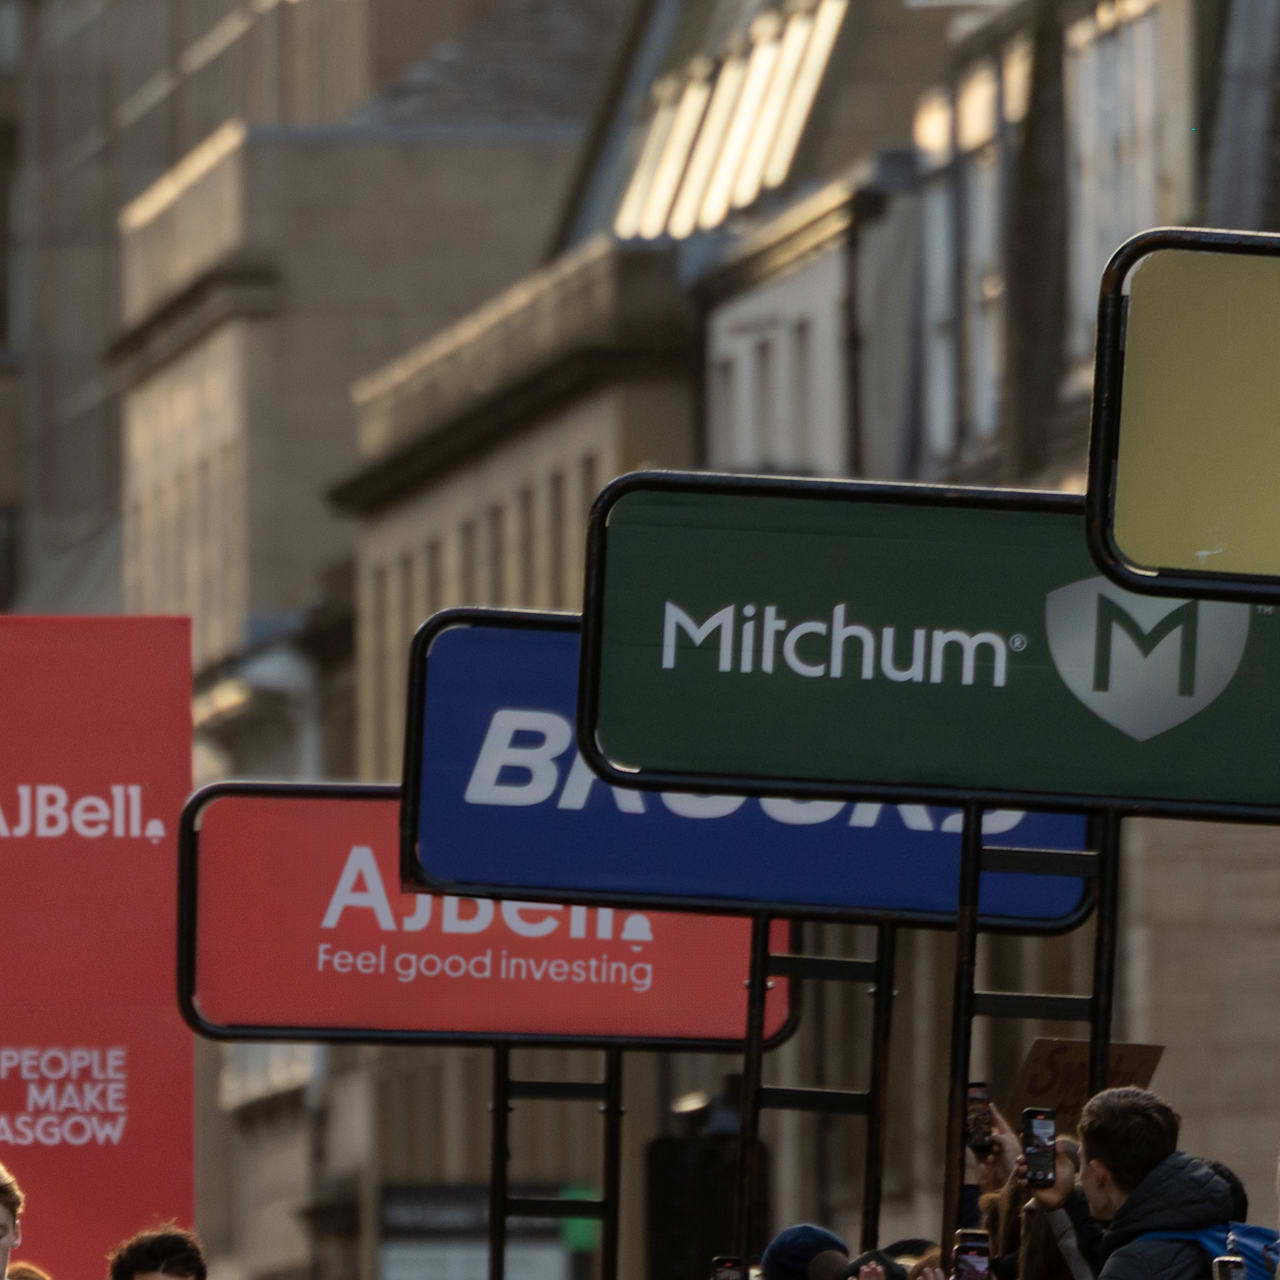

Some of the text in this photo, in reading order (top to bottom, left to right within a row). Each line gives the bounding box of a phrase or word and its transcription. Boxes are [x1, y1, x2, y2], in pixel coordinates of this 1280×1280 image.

[661, 600, 1008, 687] Mitchum
[317, 943, 653, 993] Feel good investing
[25, 1082, 128, 1114] MAKE
